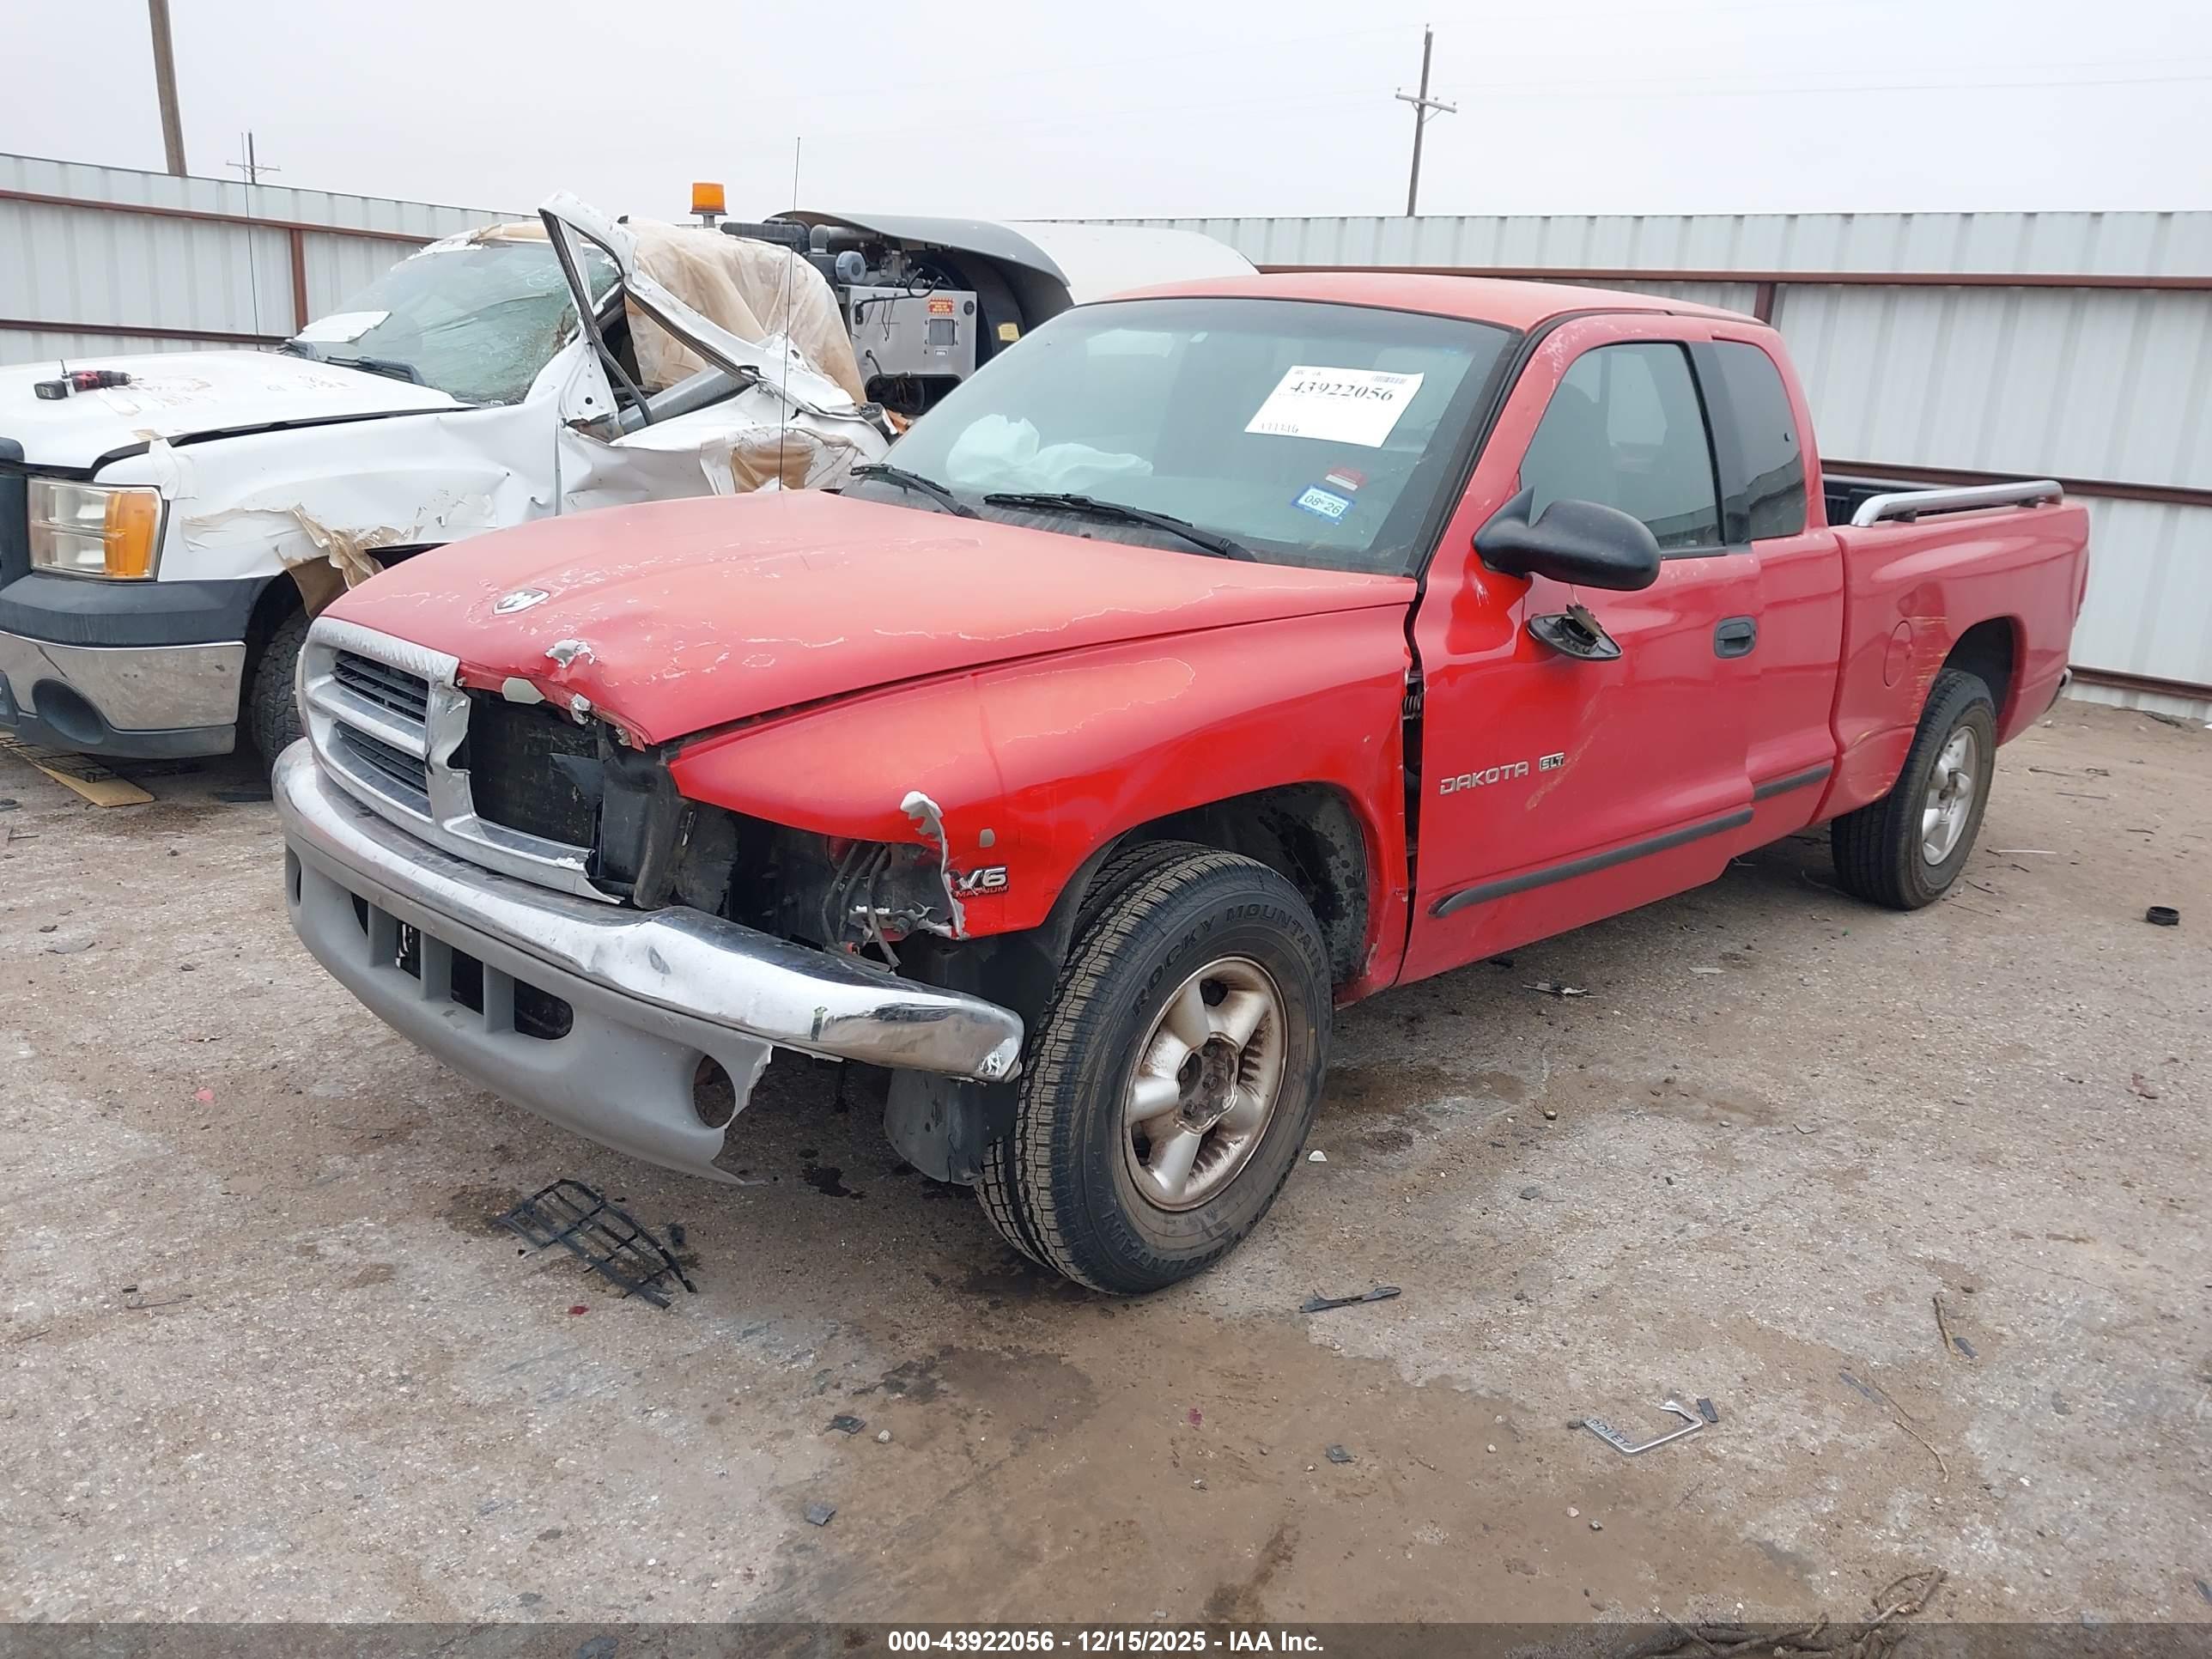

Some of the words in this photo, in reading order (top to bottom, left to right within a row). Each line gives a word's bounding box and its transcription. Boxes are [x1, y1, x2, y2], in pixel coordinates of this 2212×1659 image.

[1290, 380, 1395, 401] 43922056
[1323, 501, 1342, 514] 26
[1439, 761, 1529, 795] DAKOTA
[1540, 752, 1565, 771] SLT
[953, 866, 1007, 890] V6
[1131, 915, 1217, 1018] ROCKY
[1225, 902, 1325, 979] MOUNTAIN
